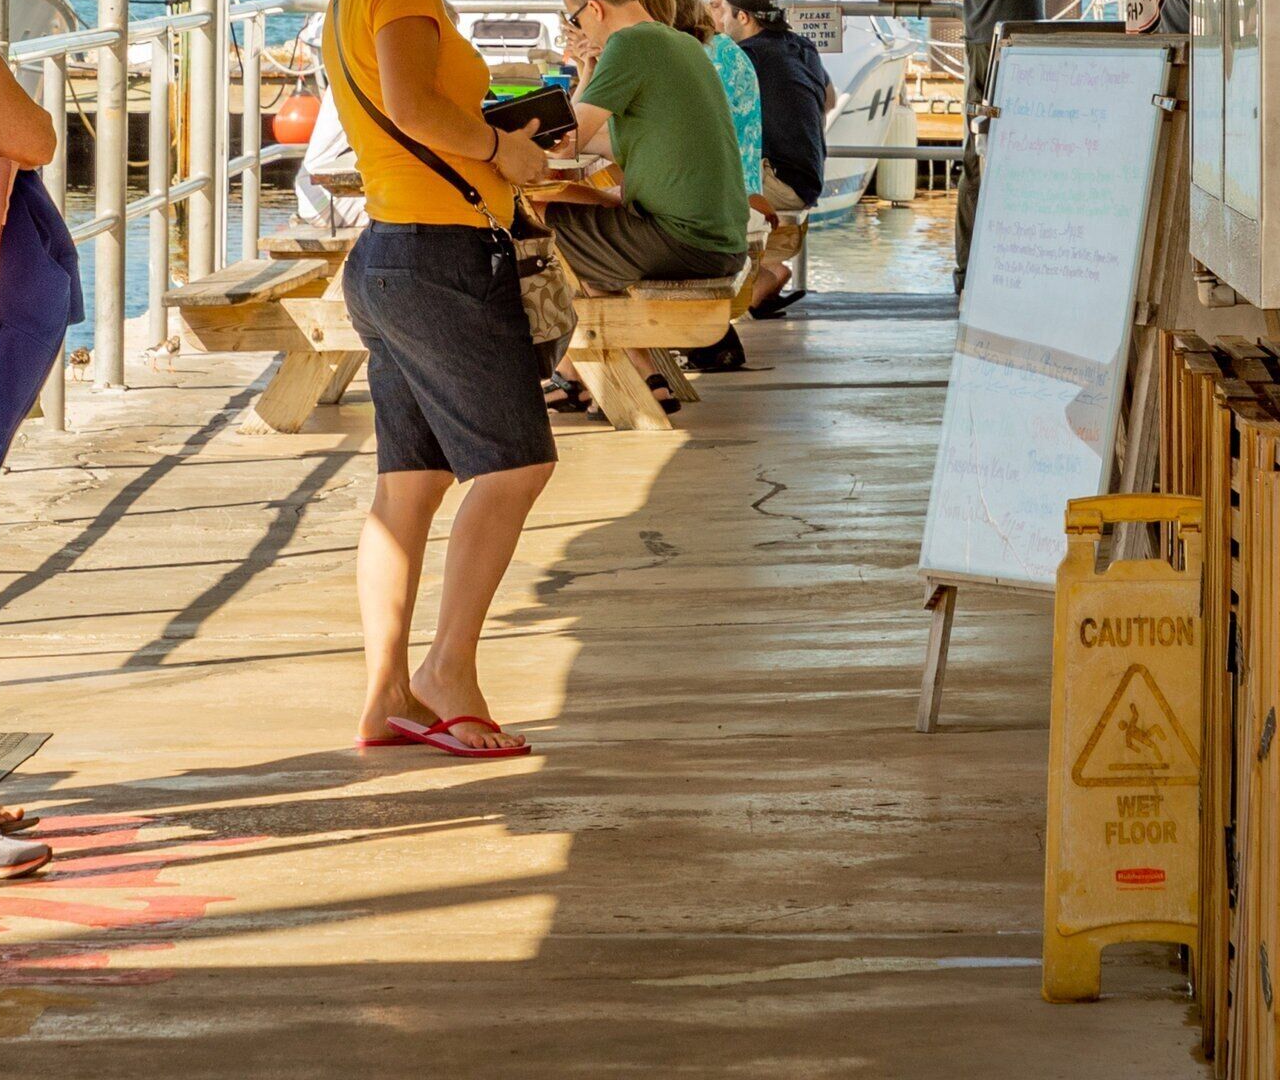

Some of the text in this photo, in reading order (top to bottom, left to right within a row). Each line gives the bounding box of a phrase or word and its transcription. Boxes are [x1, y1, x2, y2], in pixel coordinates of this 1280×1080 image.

[800, 12, 831, 20] PLEASE
[1080, 616, 1194, 648] CAUTION
[1116, 795, 1164, 818] WET
[1105, 821, 1178, 848] FLOOR
